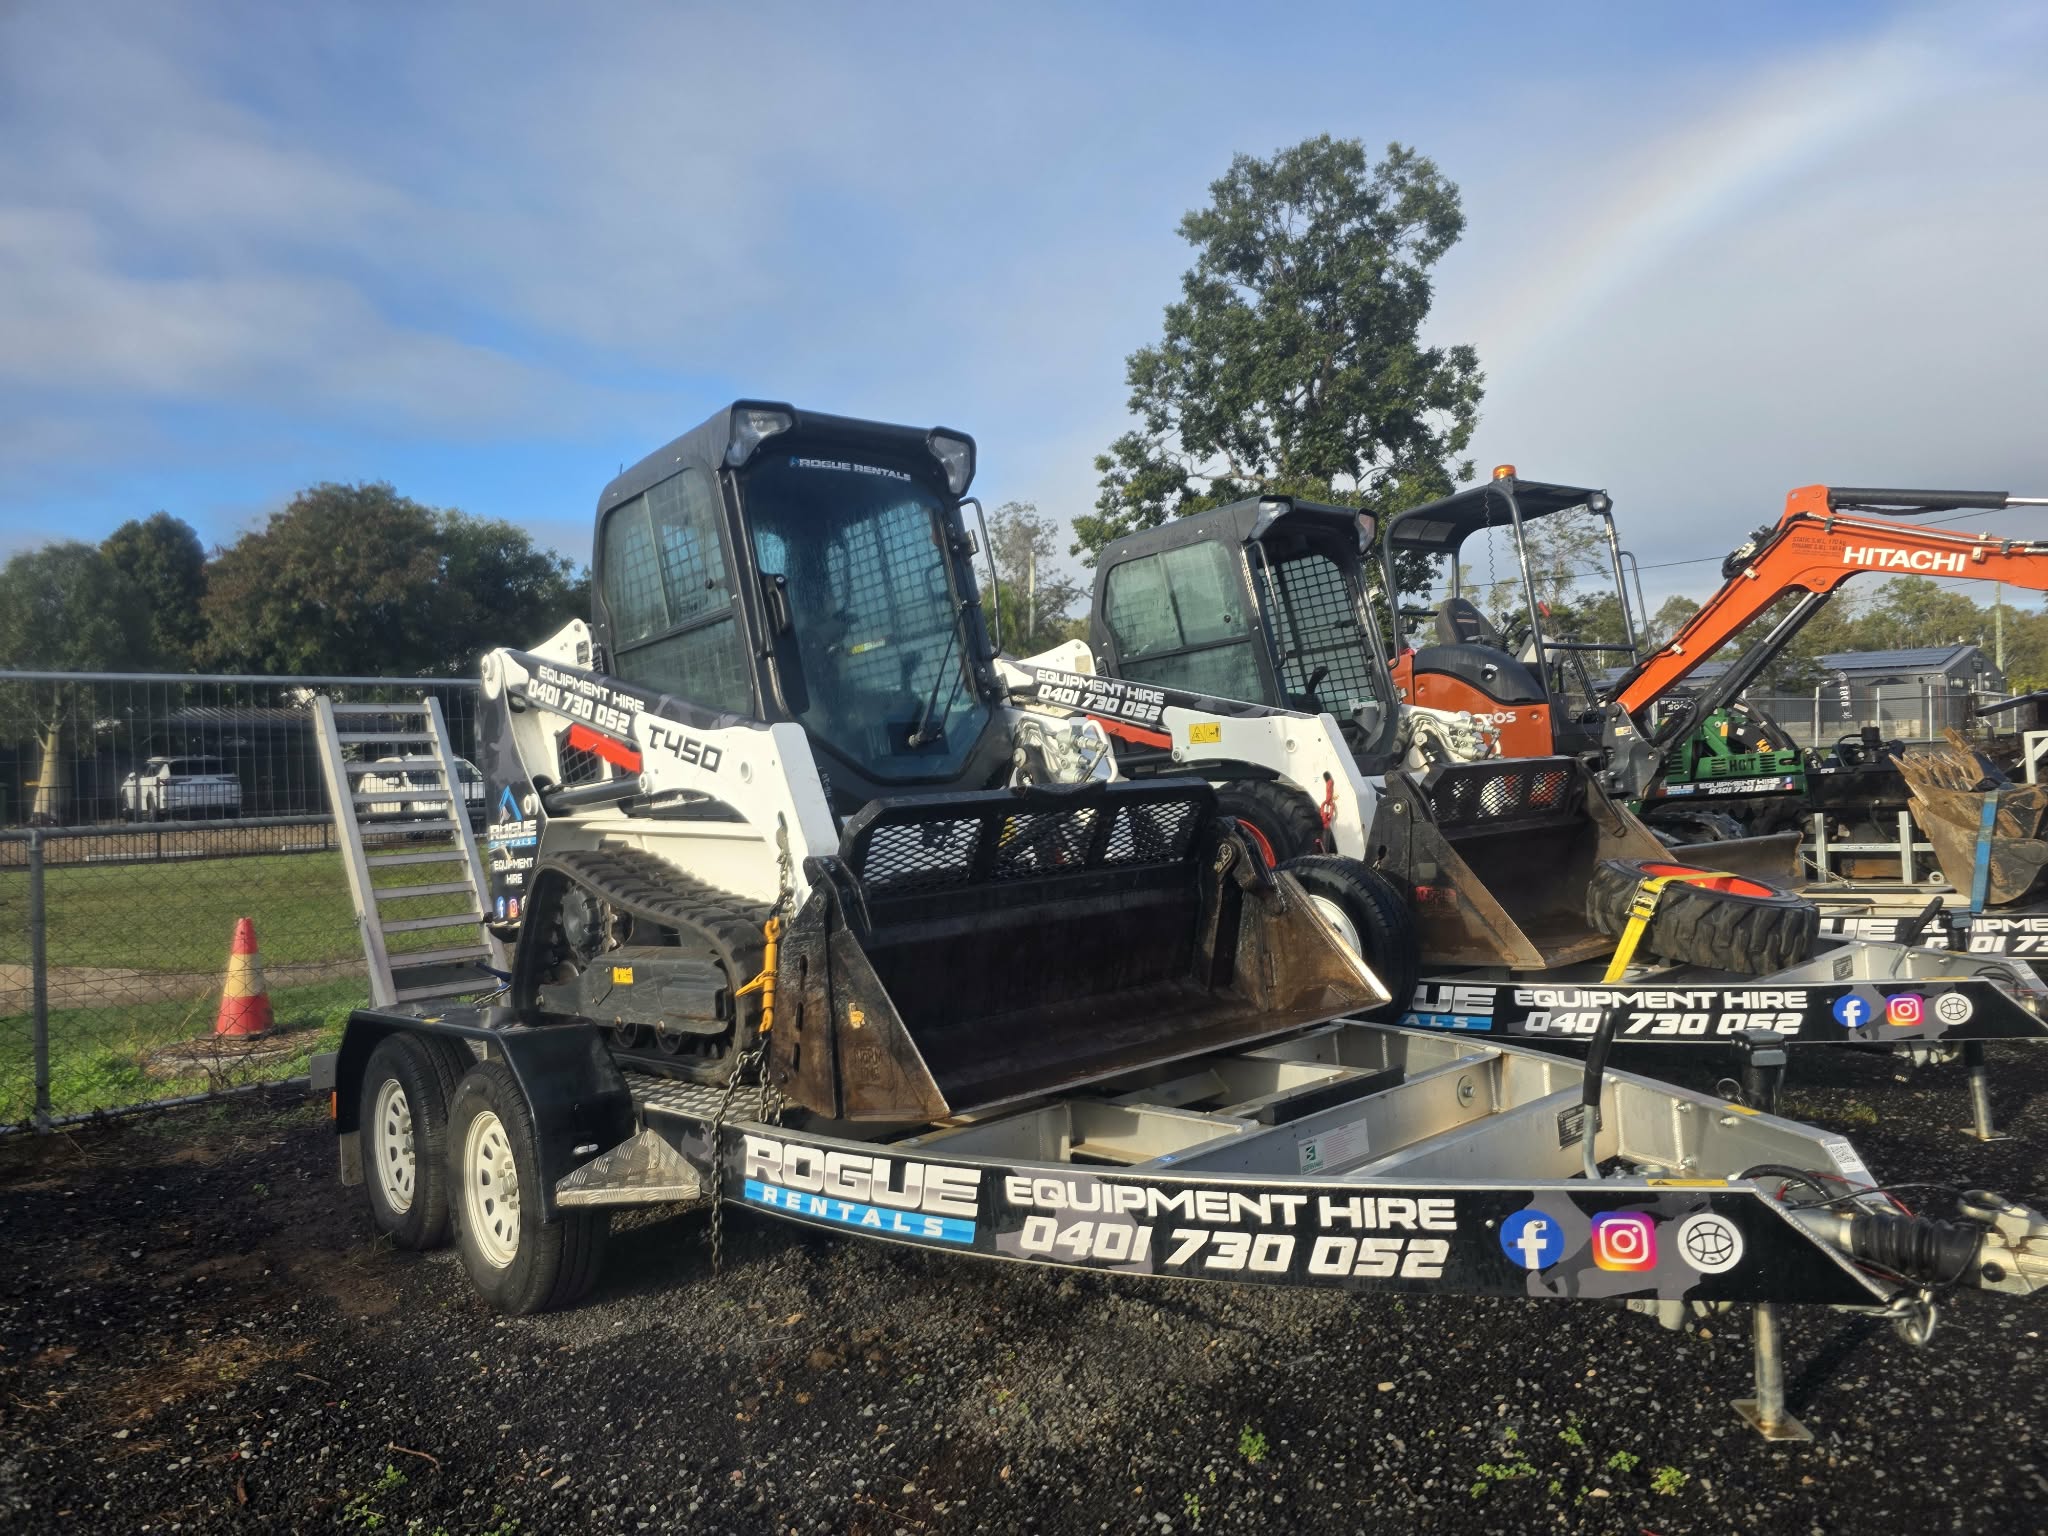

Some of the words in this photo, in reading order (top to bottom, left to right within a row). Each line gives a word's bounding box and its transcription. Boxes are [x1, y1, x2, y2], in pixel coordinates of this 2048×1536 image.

[799, 458, 851, 470] ROGUE
[854, 465, 911, 481] RENTALS
[1843, 546, 1967, 572] HITACHI
[539, 665, 610, 701] EQUIPMENT
[612, 692, 644, 712] HIRE
[1036, 669, 1125, 696] EQUIPMENT
[1126, 686, 1165, 705] HIRE
[1038, 684, 1080, 705] 0401
[1081, 693, 1120, 713] 730
[1121, 701, 1162, 721] 052
[528, 678, 561, 707] 0401
[561, 692, 594, 722] 730
[595, 704, 631, 735] 052
[648, 723, 723, 773] T450
[489, 820, 537, 841] ROGUE
[493, 857, 534, 871] EQUIPMENT
[506, 873, 523, 884] HIRE
[1514, 989, 1718, 1009] EQUIPMENT
[1723, 990, 1808, 1009] HIRE
[1524, 1011, 1602, 1034] 040
[1624, 1012, 1709, 1035] 730
[1716, 1012, 1804, 1035] 052
[742, 1134, 981, 1218] ROGUE
[1005, 1175, 1306, 1227] EQUIPMENT
[1318, 1196, 1458, 1232] HIRE
[762, 1184, 944, 1237] RENTALS
[1020, 1216, 1153, 1262] 0401
[1164, 1228, 1297, 1274] 730
[1307, 1236, 1450, 1279] 052
